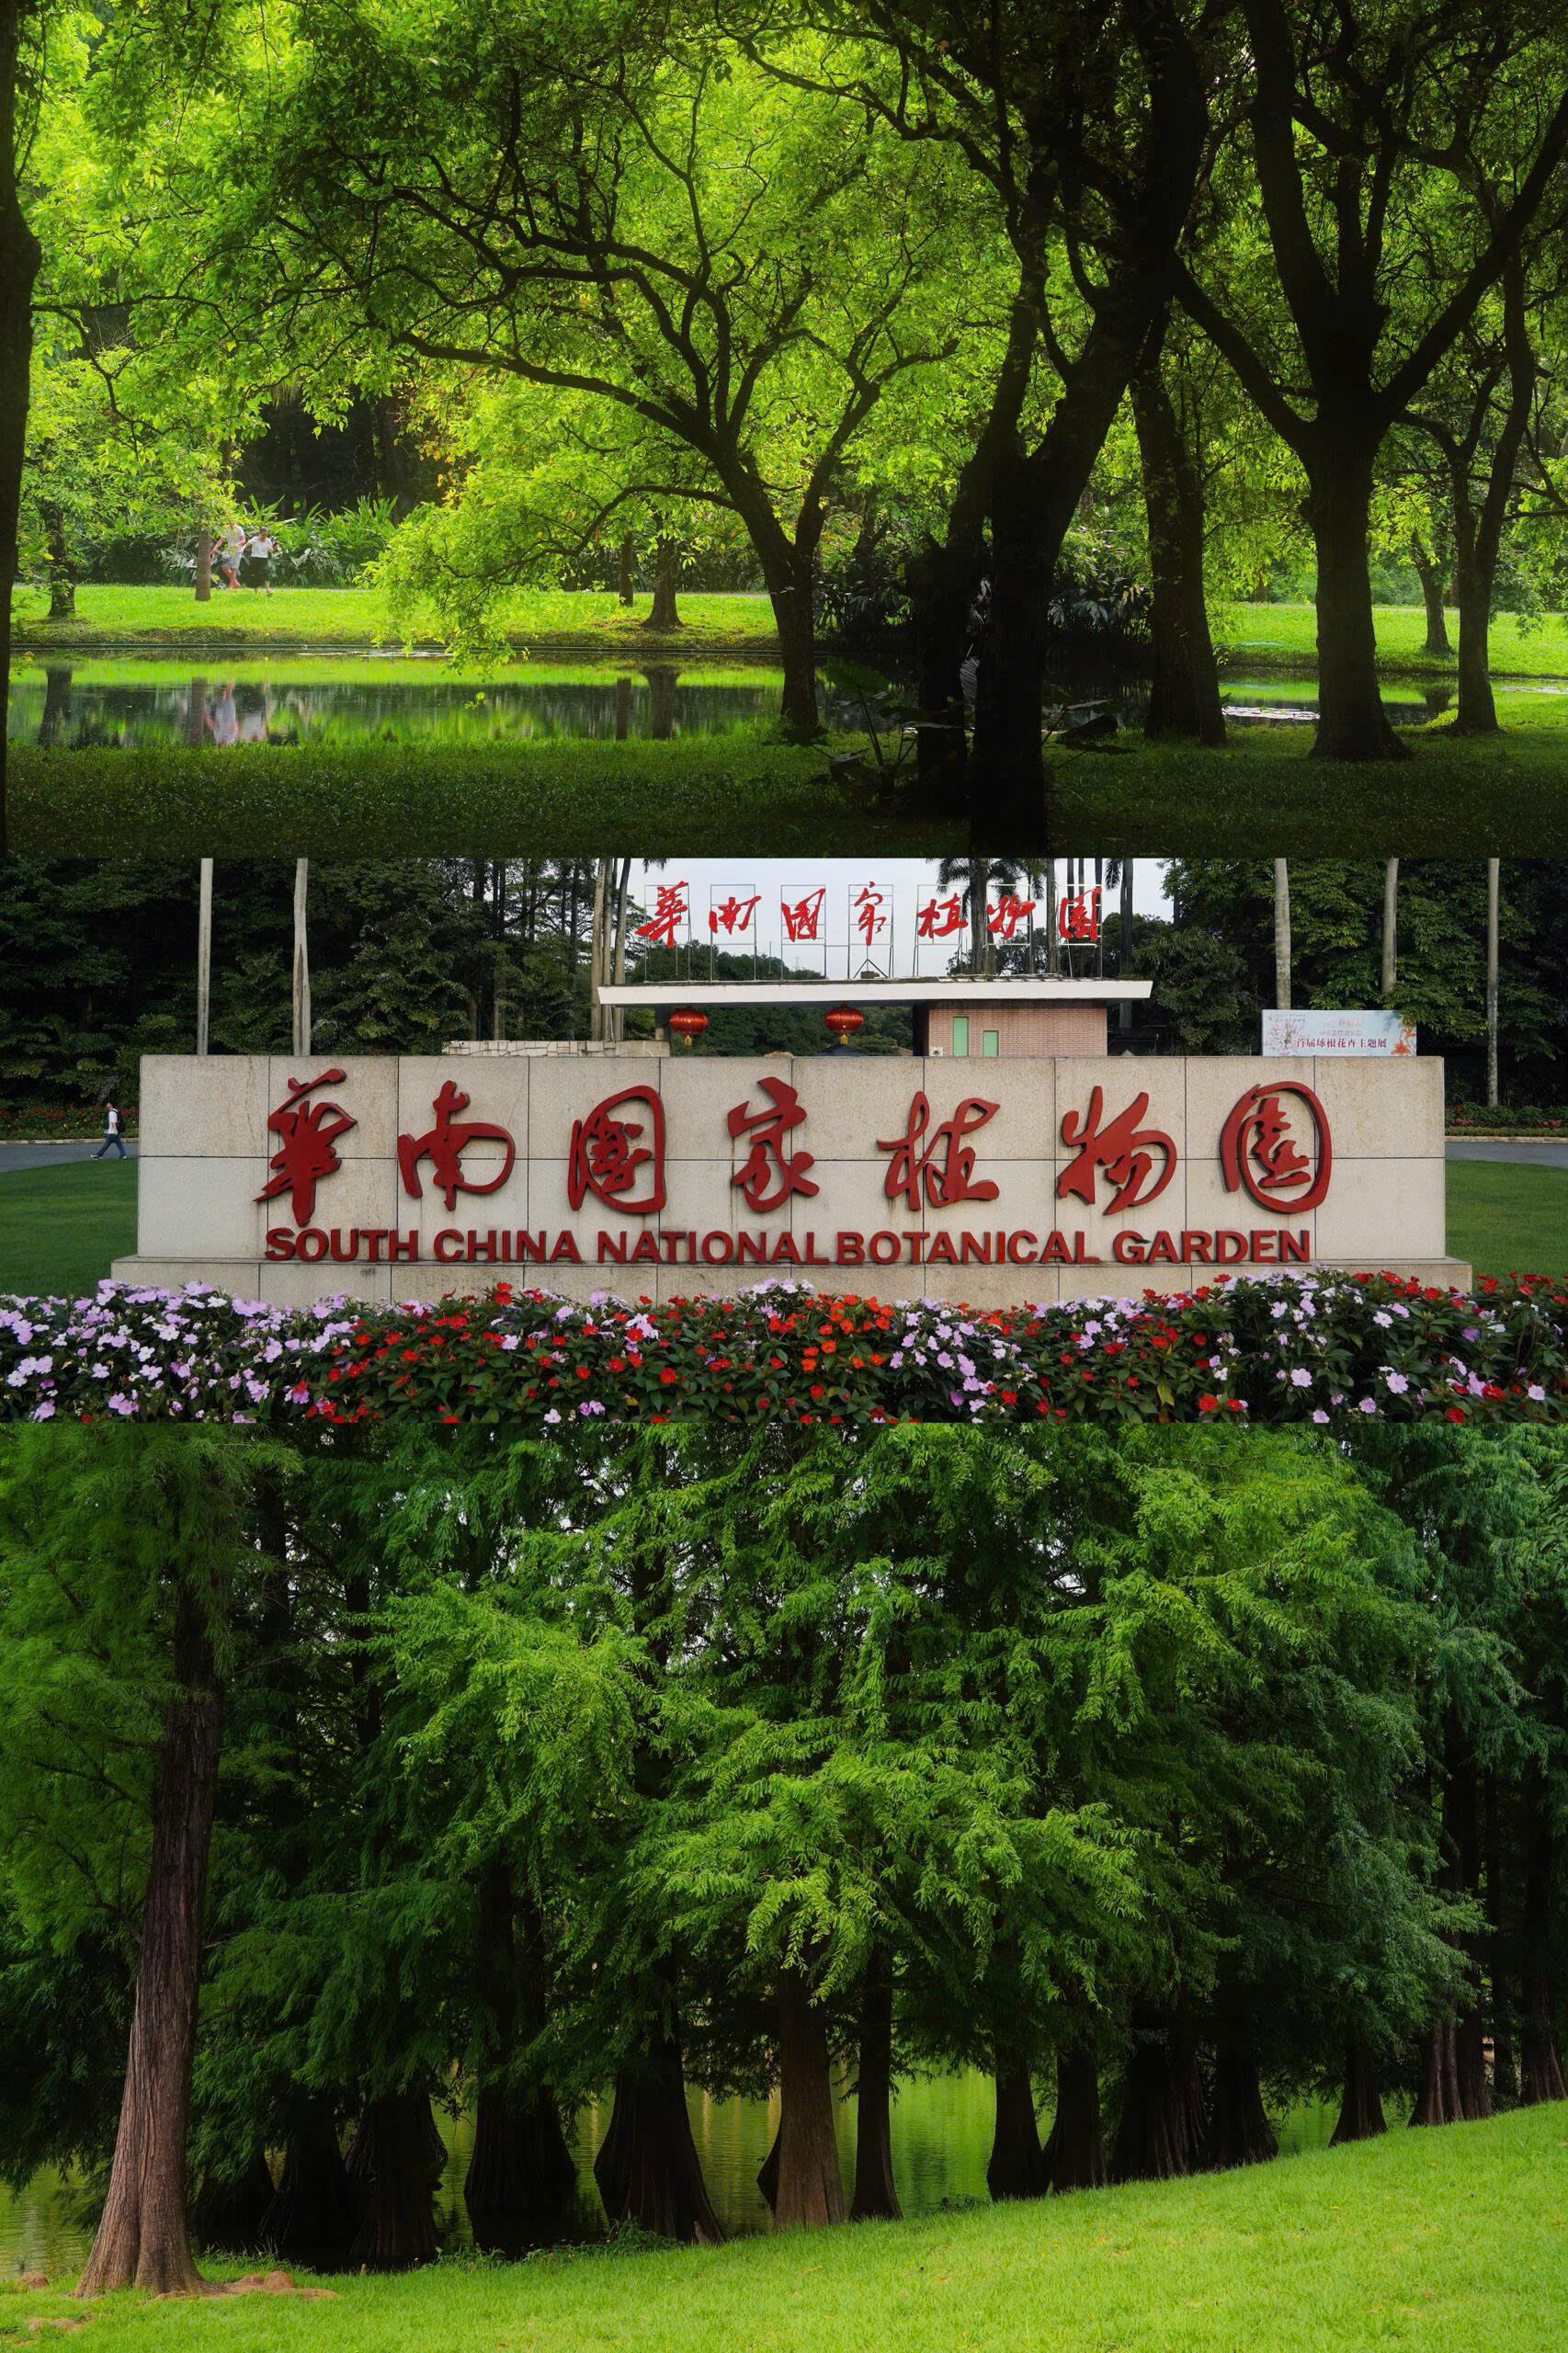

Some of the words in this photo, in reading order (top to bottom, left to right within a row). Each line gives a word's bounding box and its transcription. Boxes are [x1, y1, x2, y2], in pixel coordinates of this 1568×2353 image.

[1296, 1037, 1387, 1048] 首届球根花卉主题展
[265, 1226, 418, 1262] SOUTH
[433, 1228, 583, 1263] CHINA
[597, 1230, 829, 1265] NATIONAL
[835, 1230, 1101, 1266] BOTANICAL
[1113, 1228, 1311, 1264] GARDEN
